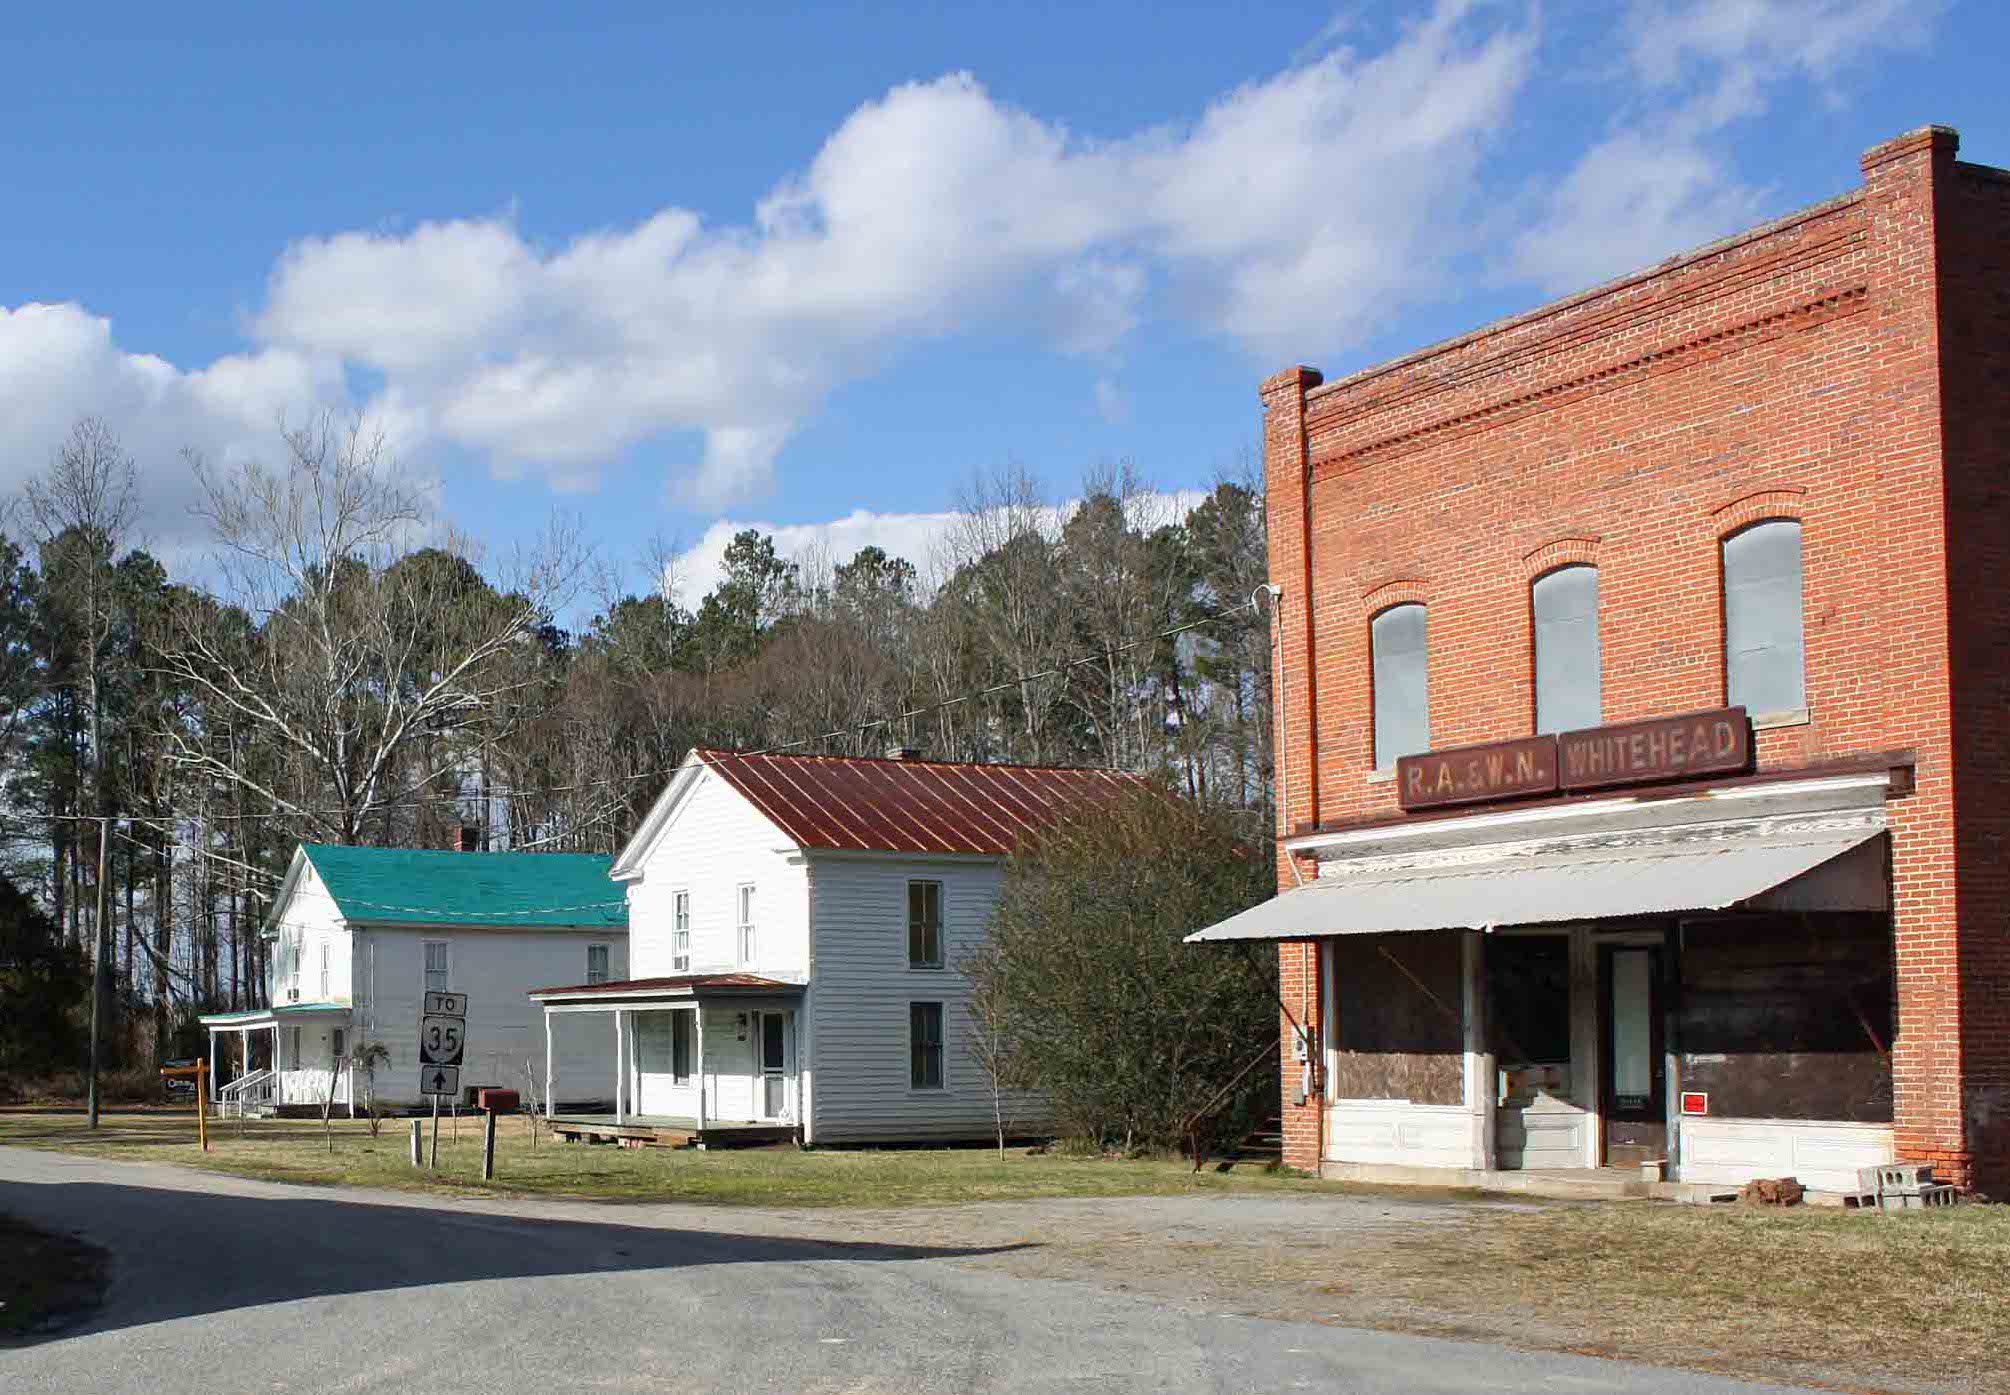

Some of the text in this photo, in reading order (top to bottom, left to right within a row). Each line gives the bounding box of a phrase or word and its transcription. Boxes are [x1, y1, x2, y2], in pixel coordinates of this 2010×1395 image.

[1567, 721, 1736, 777] WHITEHEAD
[436, 997, 455, 1010] TO
[428, 1026, 457, 1051] 35
